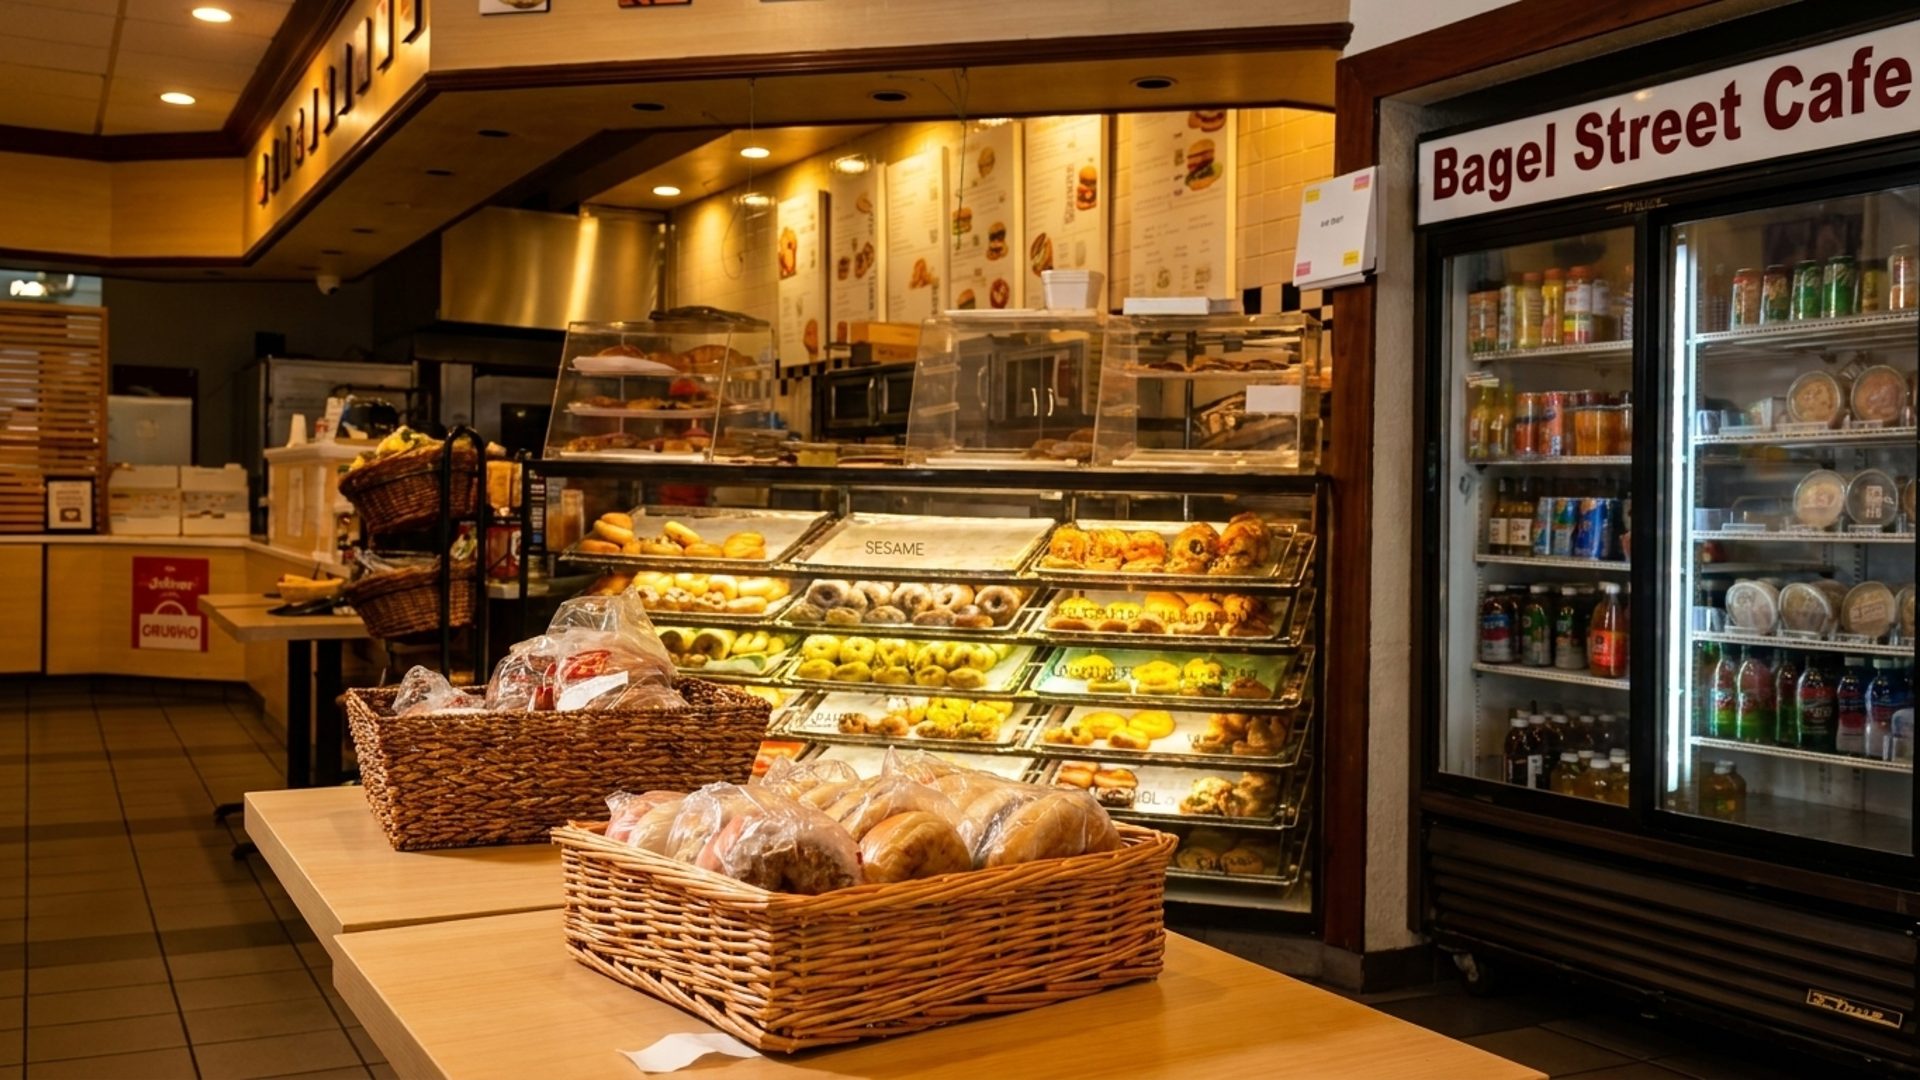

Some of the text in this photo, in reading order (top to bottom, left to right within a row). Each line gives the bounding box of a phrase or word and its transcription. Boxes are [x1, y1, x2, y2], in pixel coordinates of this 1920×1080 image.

[1433, 46, 1912, 202] Bagel Street Cafe
[865, 540, 925, 556] SESAME
